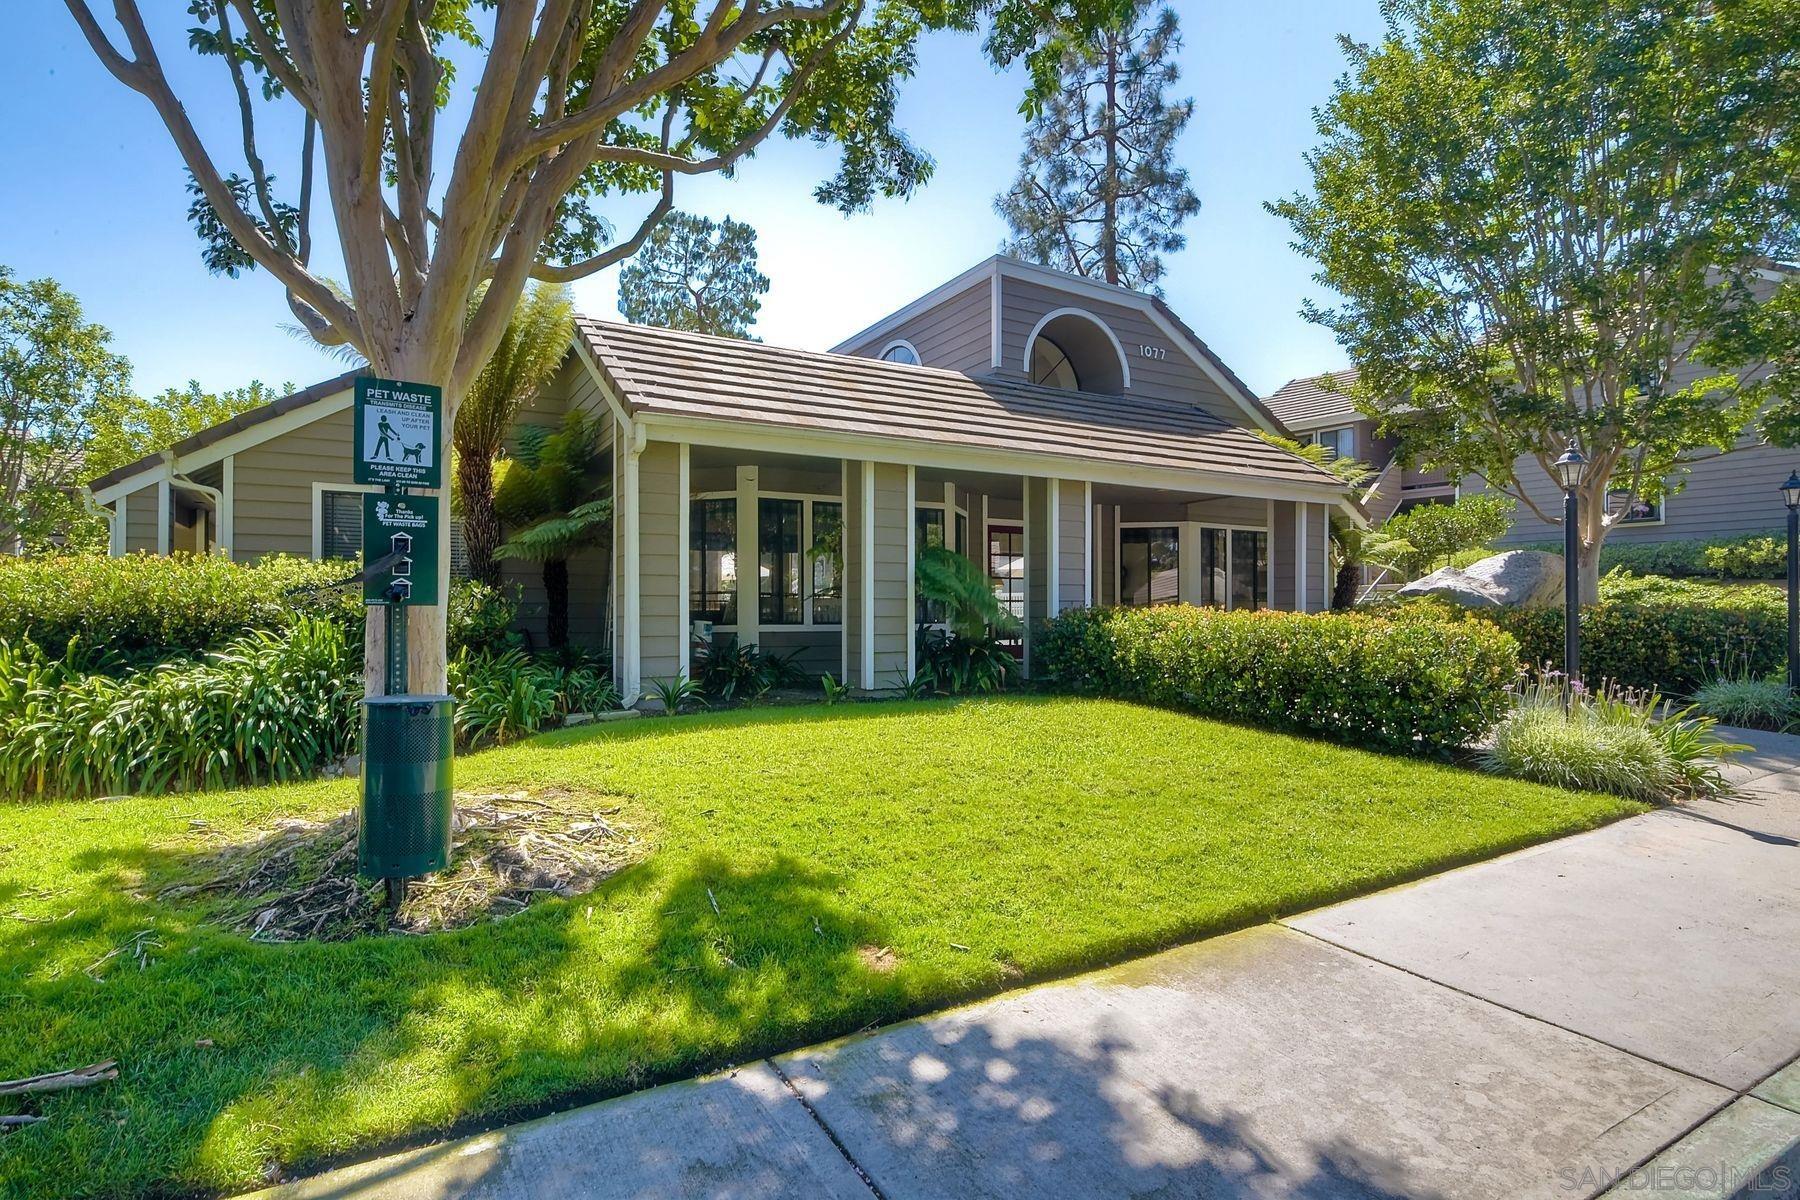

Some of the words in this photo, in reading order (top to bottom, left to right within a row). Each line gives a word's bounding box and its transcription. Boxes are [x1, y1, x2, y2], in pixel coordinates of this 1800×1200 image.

[1140, 345, 1166, 359] 1077
[366, 388, 390, 399] PET
[392, 391, 432, 404] WASTE
